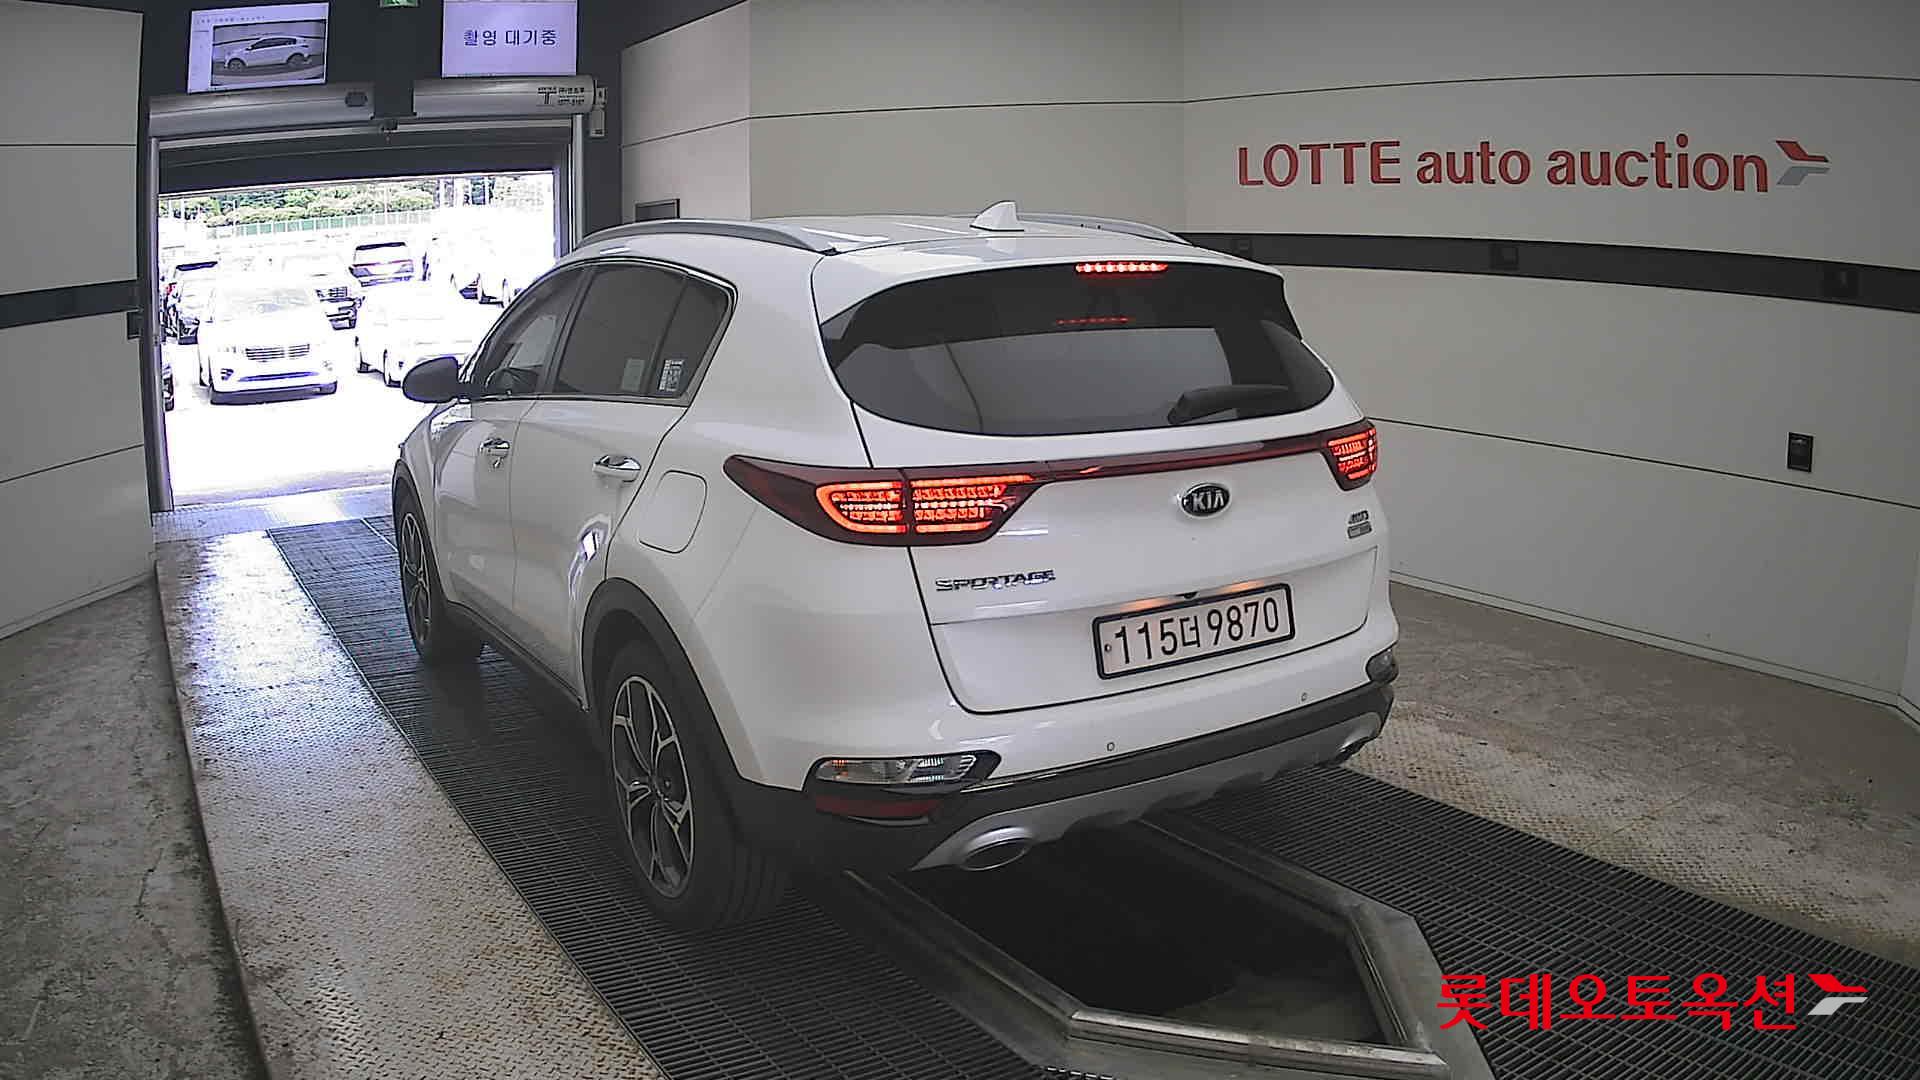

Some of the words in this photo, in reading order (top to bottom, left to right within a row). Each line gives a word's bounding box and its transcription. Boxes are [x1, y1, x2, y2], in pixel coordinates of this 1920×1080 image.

[505, 29, 557, 46] 대기중
[1238, 140, 1400, 187] LOTTE
[1417, 141, 1531, 185] auto
[1546, 133, 1768, 193] auction
[935, 569, 1056, 592] SPORTAGE
